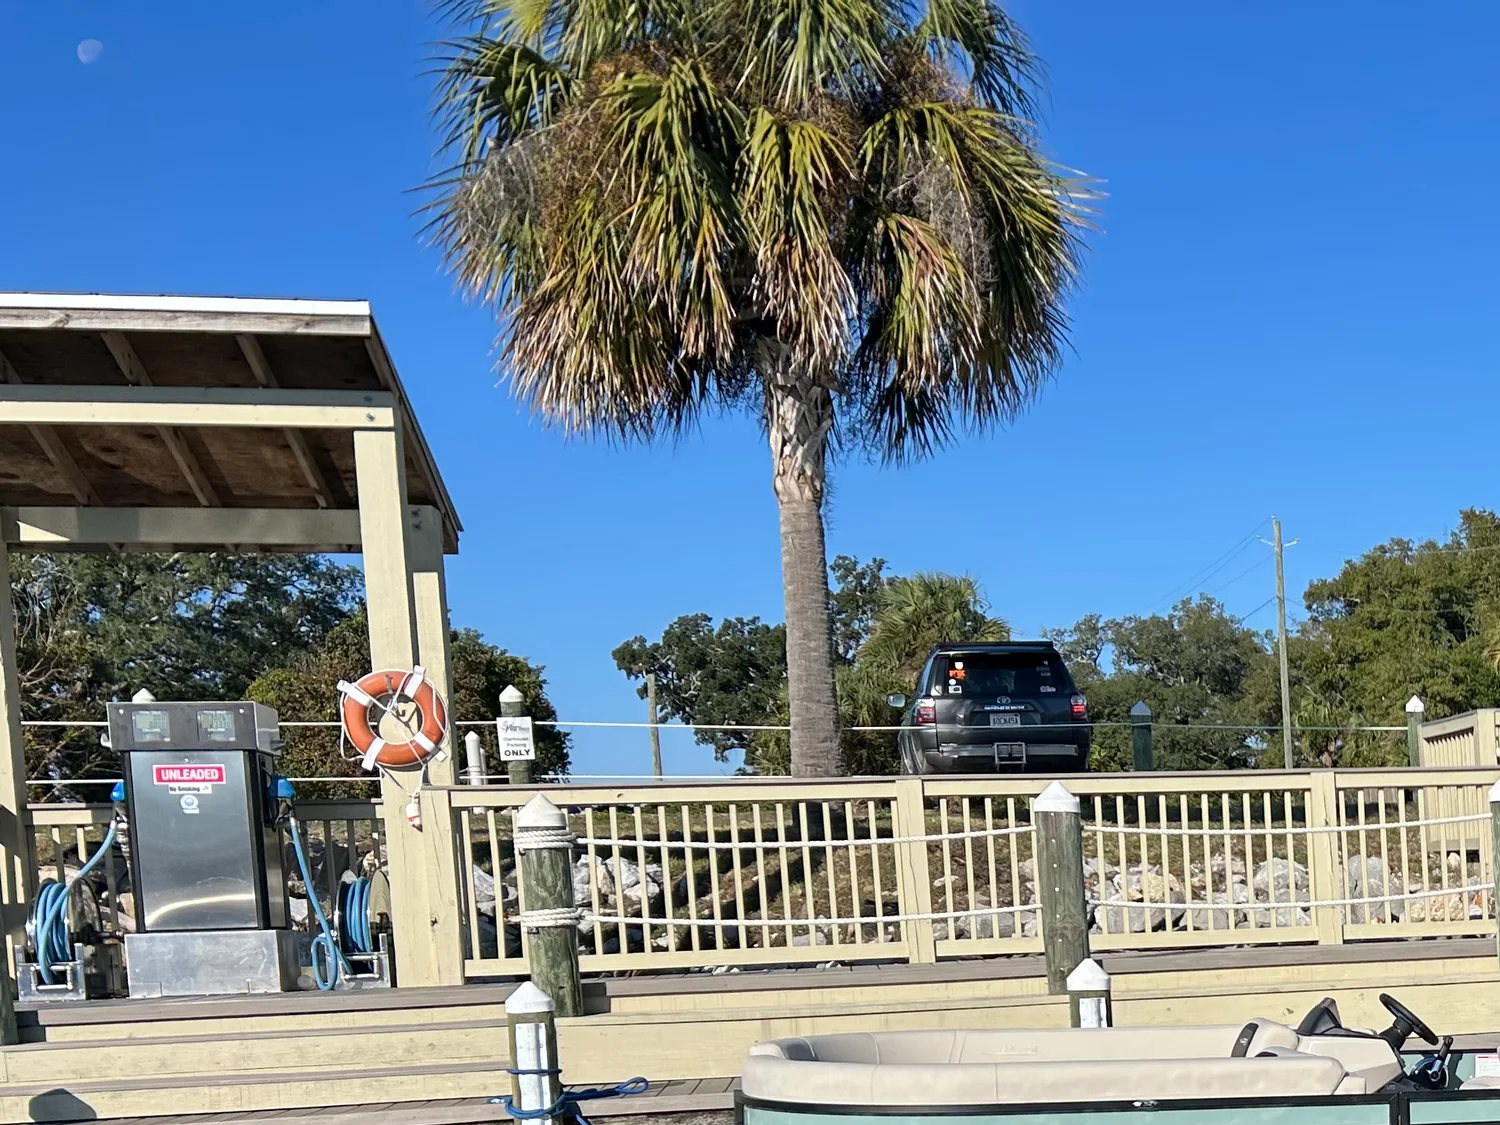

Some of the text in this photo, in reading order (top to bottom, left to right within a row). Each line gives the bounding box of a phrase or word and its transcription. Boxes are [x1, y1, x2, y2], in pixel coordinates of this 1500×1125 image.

[504, 748, 531, 757] ONLY
[160, 768, 219, 781] UNLEADED
[177, 785, 201, 793] Smoking
